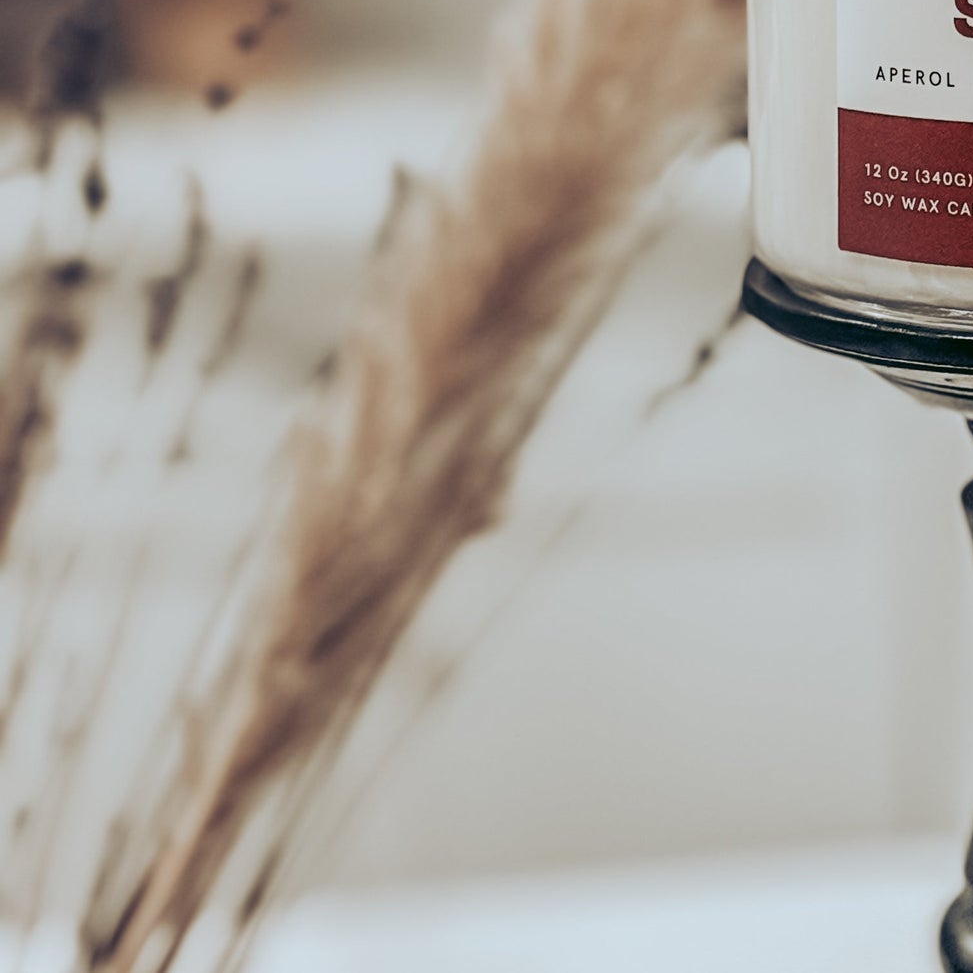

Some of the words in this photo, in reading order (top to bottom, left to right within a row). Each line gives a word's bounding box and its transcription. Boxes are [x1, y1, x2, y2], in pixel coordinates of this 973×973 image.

[875, 65, 955, 88] APEROL
[864, 162, 882, 178] 12
[915, 169, 973, 188] (340G)
[863, 190, 895, 208] SOY
[901, 195, 940, 214] WAX
